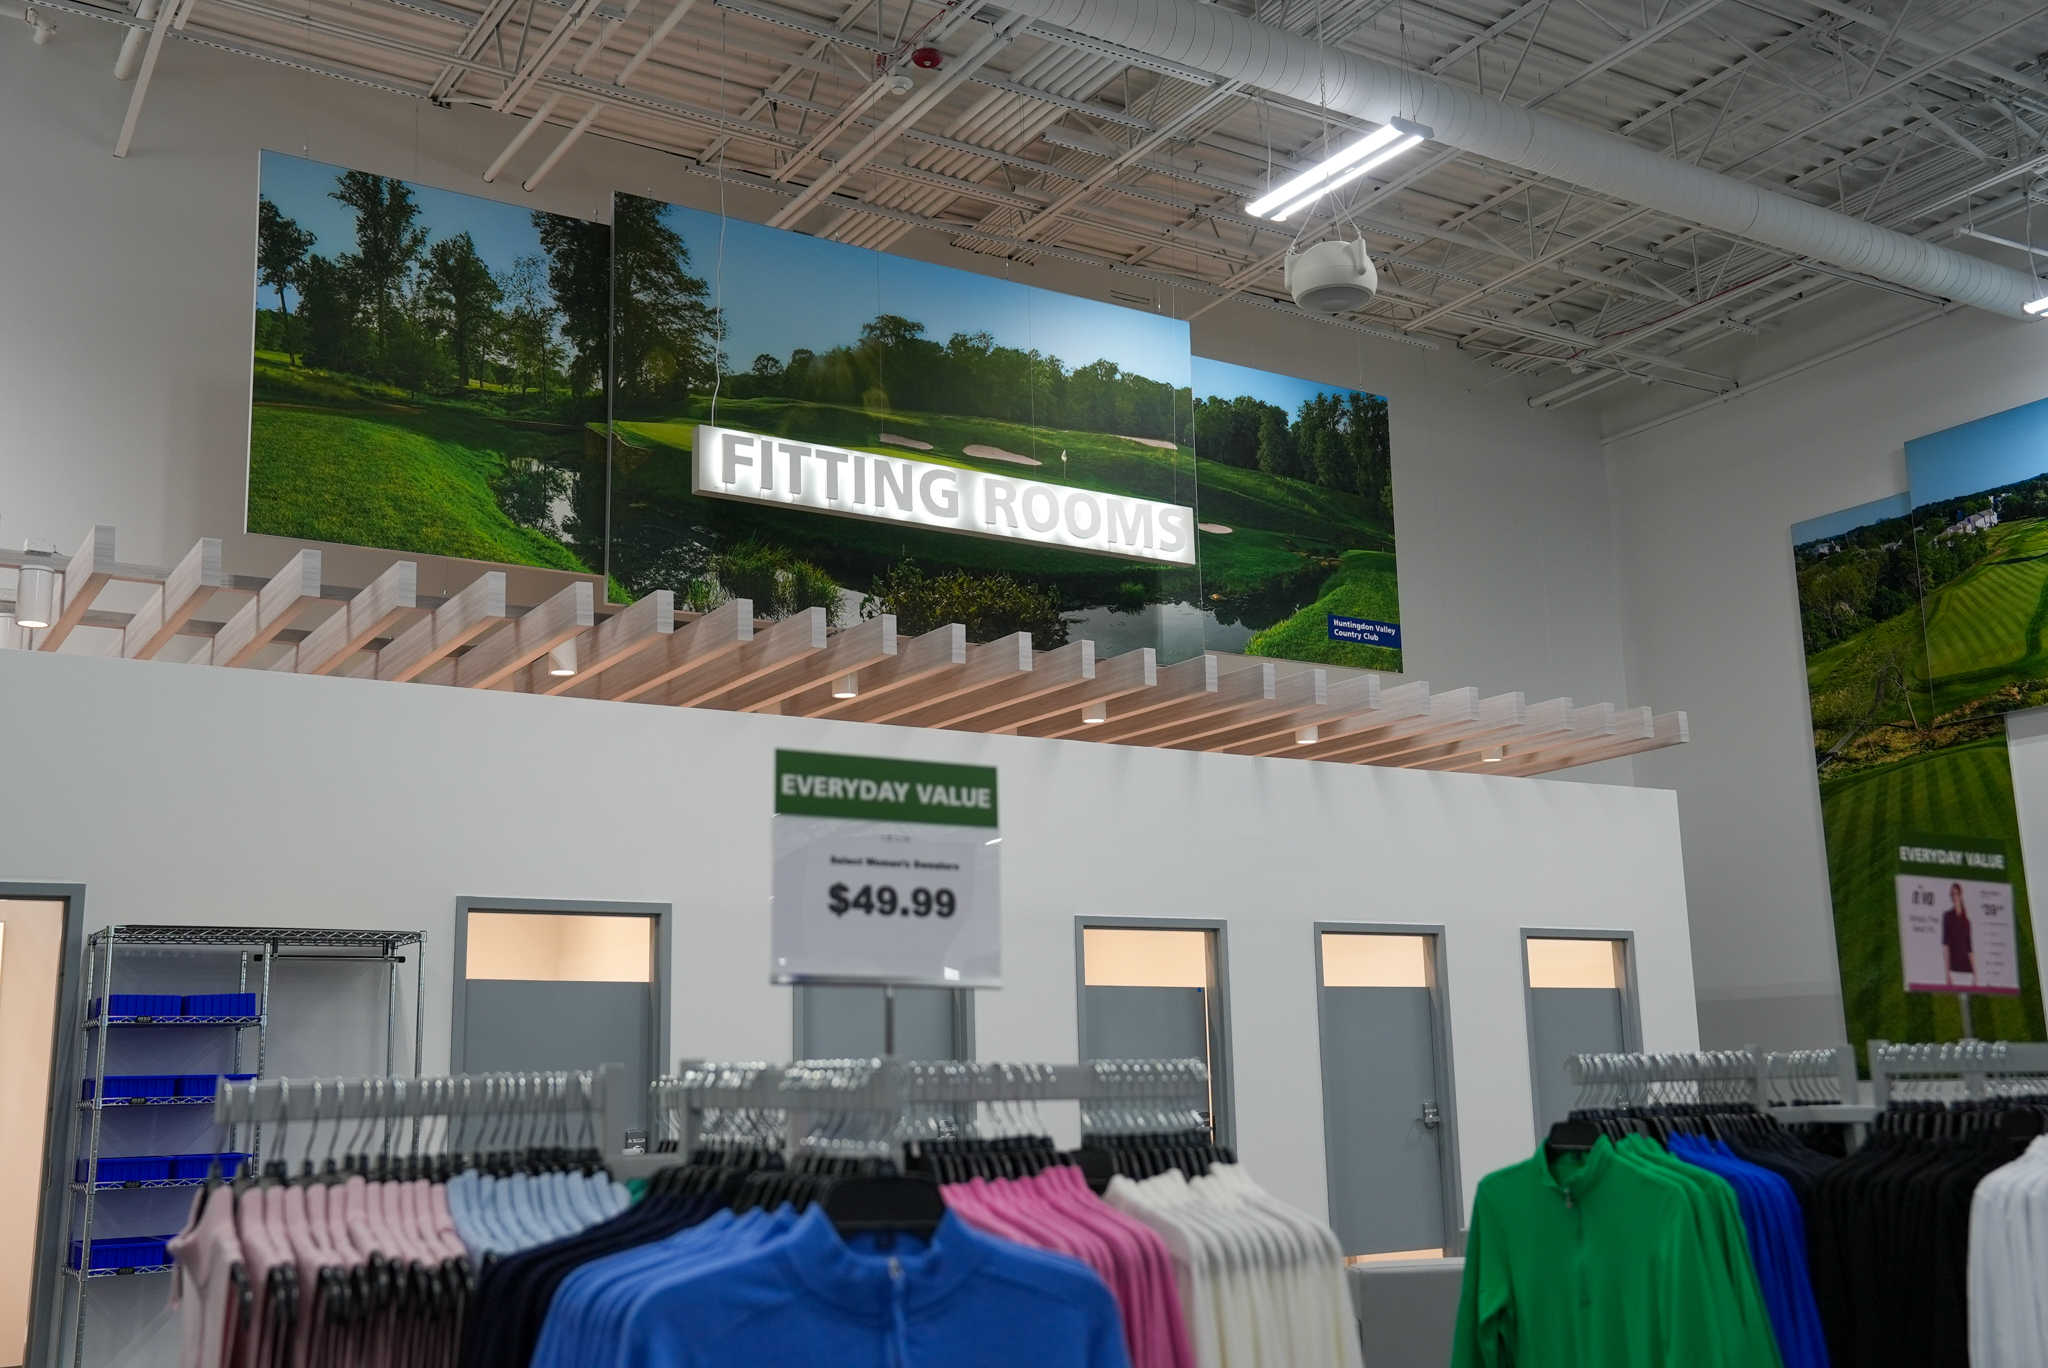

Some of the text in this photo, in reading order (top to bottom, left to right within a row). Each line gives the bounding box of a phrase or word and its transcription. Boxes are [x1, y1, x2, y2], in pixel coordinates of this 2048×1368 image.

[722, 434, 1186, 552] FITTING ROOMS
[1333, 619, 1396, 636] Huntingdon Valley
[1334, 629, 1379, 641] Country Club
[781, 773, 992, 809] EVERYDAY VALUE
[1899, 846, 2005, 870] EVERYDAY VALUE
[828, 881, 957, 918] $49.99
